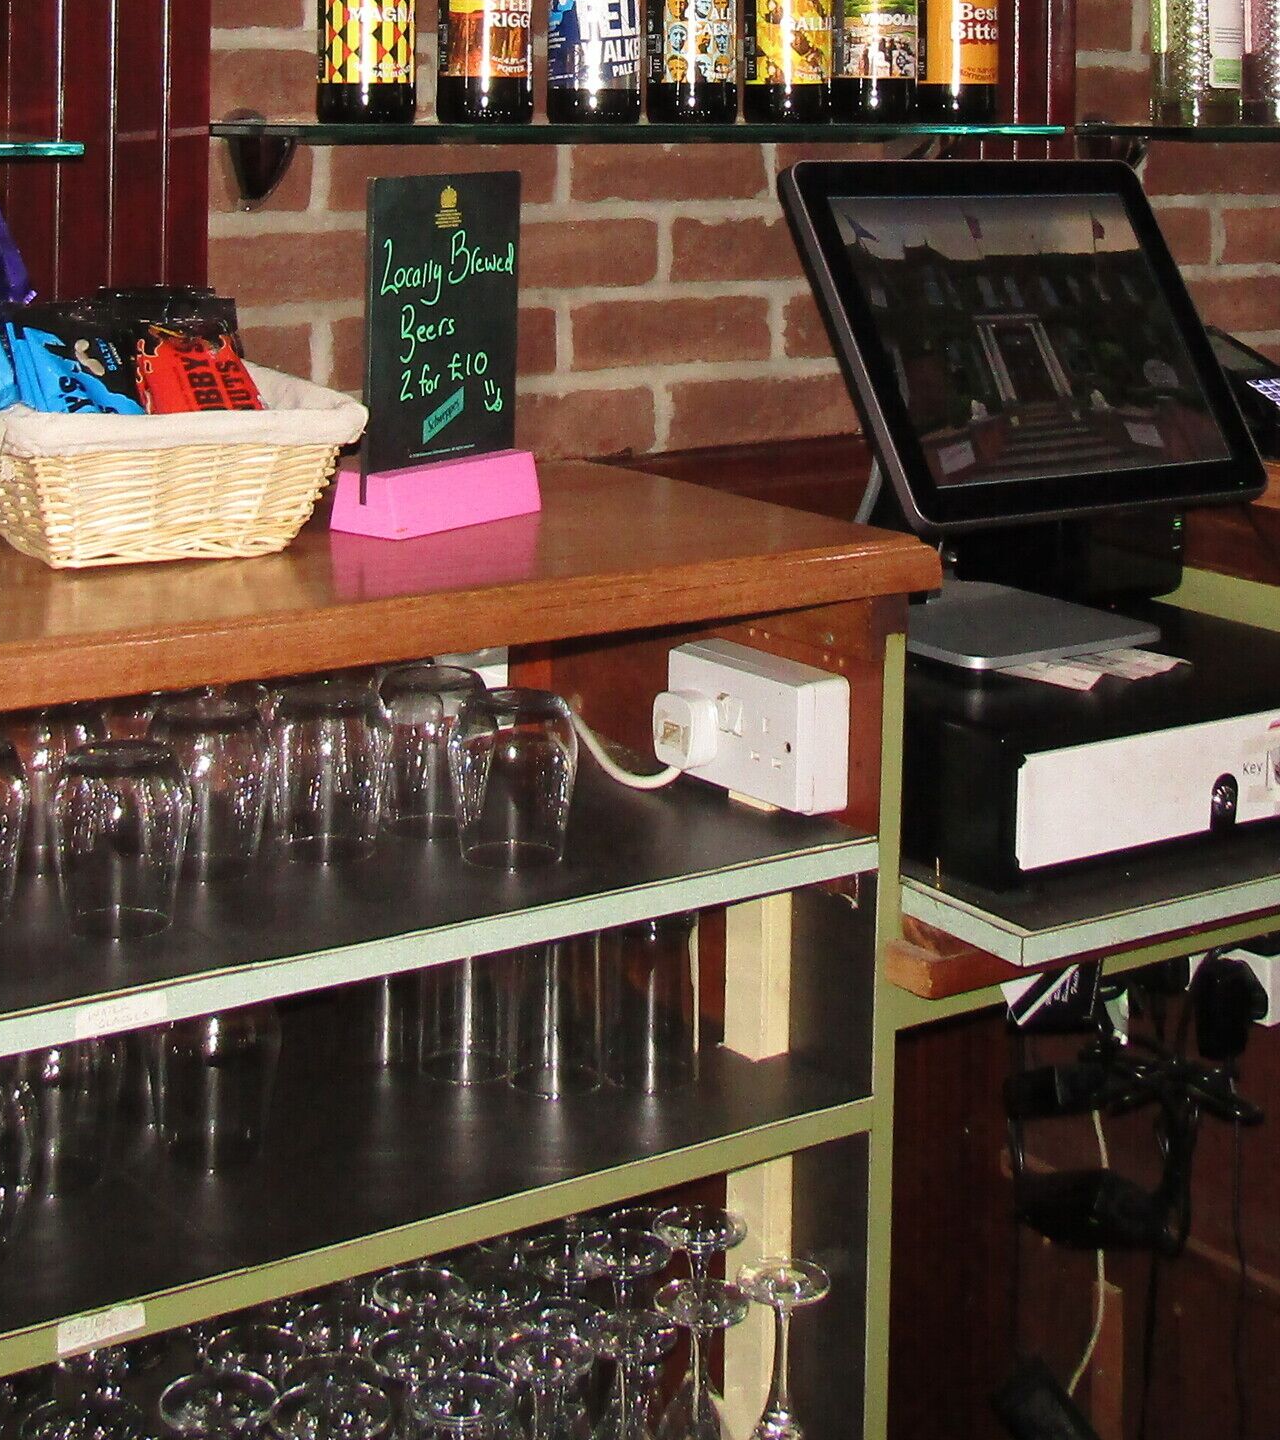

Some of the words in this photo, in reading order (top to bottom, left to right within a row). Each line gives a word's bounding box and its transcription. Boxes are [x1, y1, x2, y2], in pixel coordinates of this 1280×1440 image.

[348, 6, 415, 23] MAGNA
[488, 12, 530, 28] RIGG
[954, 3, 998, 22] Best
[951, 22, 999, 41] Bitte
[612, 62, 633, 77] PALE
[380, 239, 442, 306] Locally
[448, 229, 514, 285] Brewed
[400, 304, 455, 364] Beers
[400, 369, 414, 402] 2
[418, 363, 441, 398] for
[447, 351, 488, 381] £10
